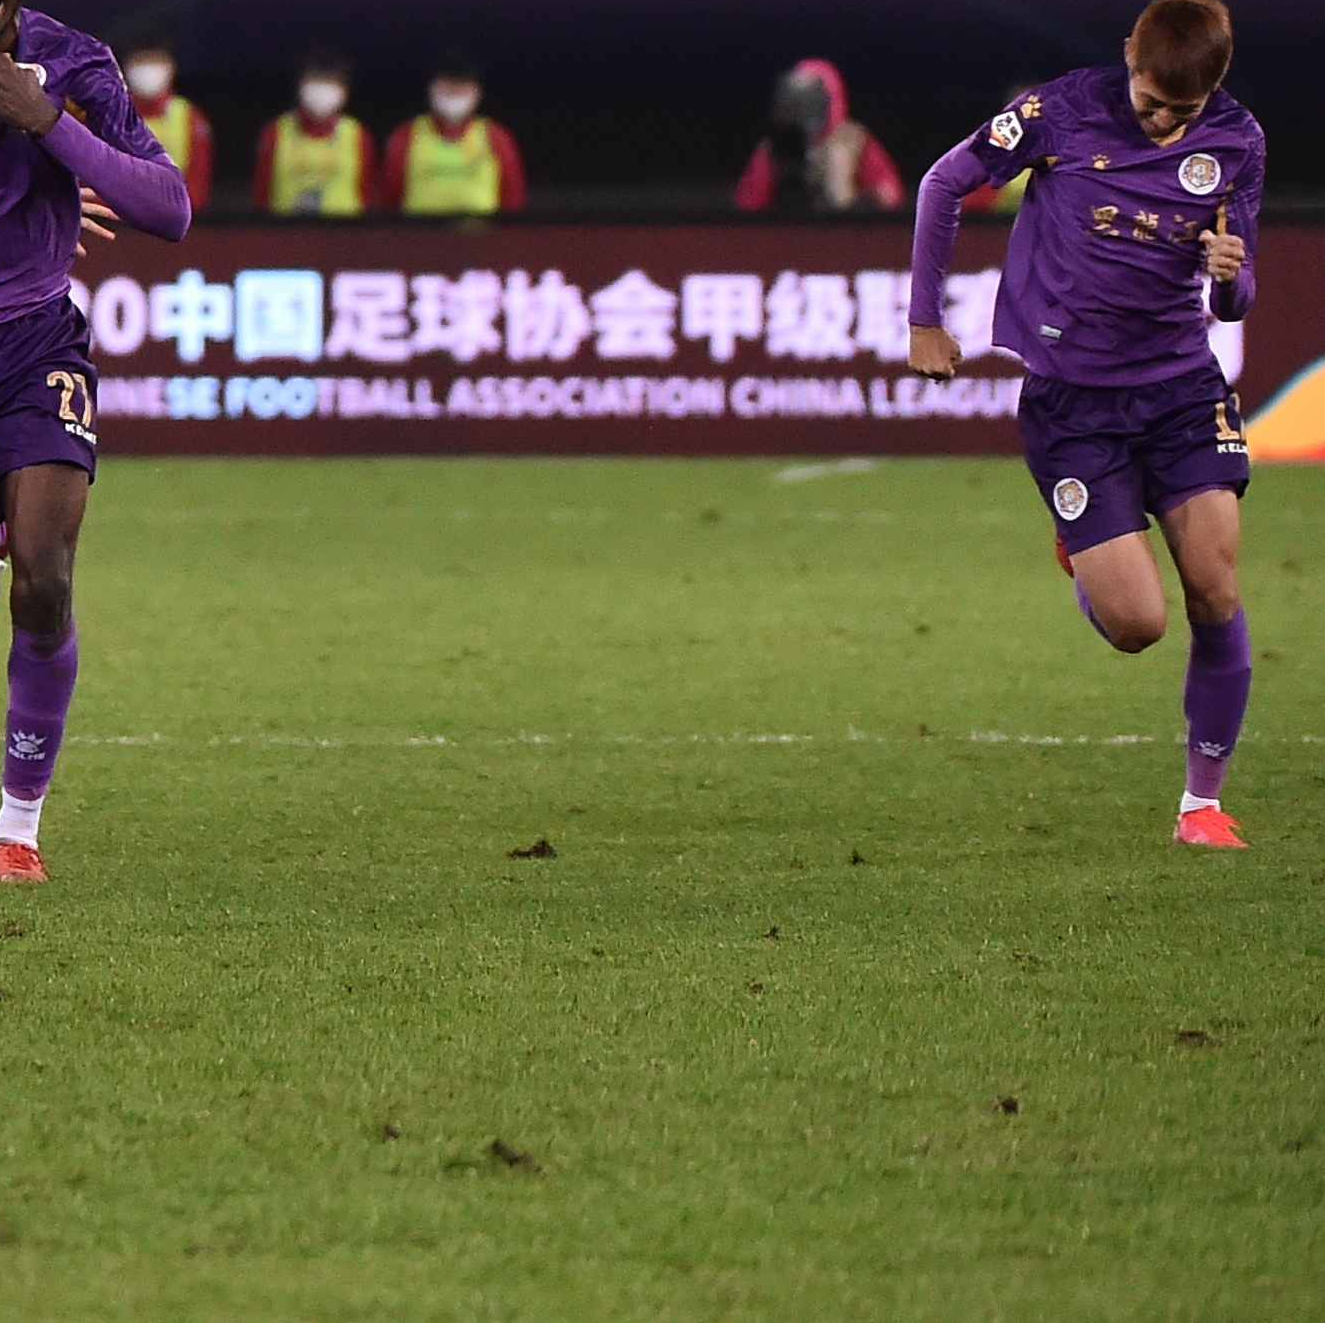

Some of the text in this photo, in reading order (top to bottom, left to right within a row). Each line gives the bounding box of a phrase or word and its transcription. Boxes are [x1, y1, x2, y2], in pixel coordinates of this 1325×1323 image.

[225, 375, 443, 420] FOOTBALL
[447, 375, 726, 420] ASSOCIATION
[728, 375, 868, 420] CHINA
